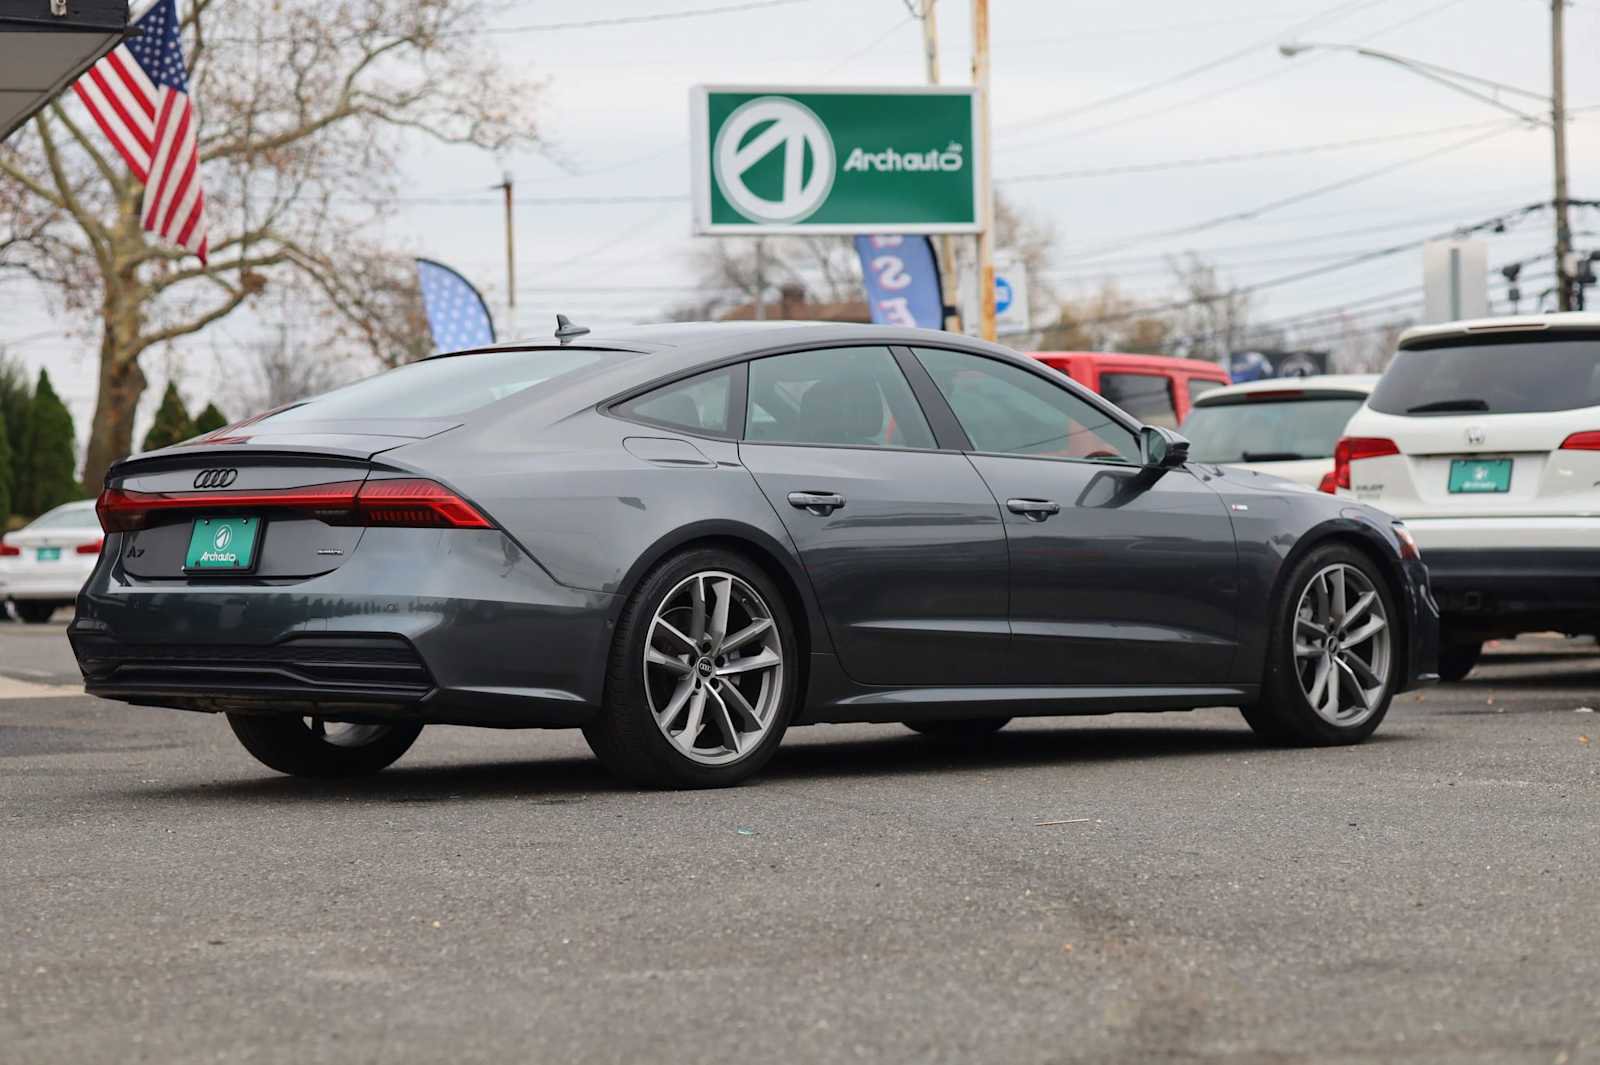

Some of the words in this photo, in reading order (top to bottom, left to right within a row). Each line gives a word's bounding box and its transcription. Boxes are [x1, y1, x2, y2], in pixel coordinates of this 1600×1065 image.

[843, 146, 963, 172] Archauto
[127, 545, 145, 558] A7
[200, 551, 237, 562] Archauto
